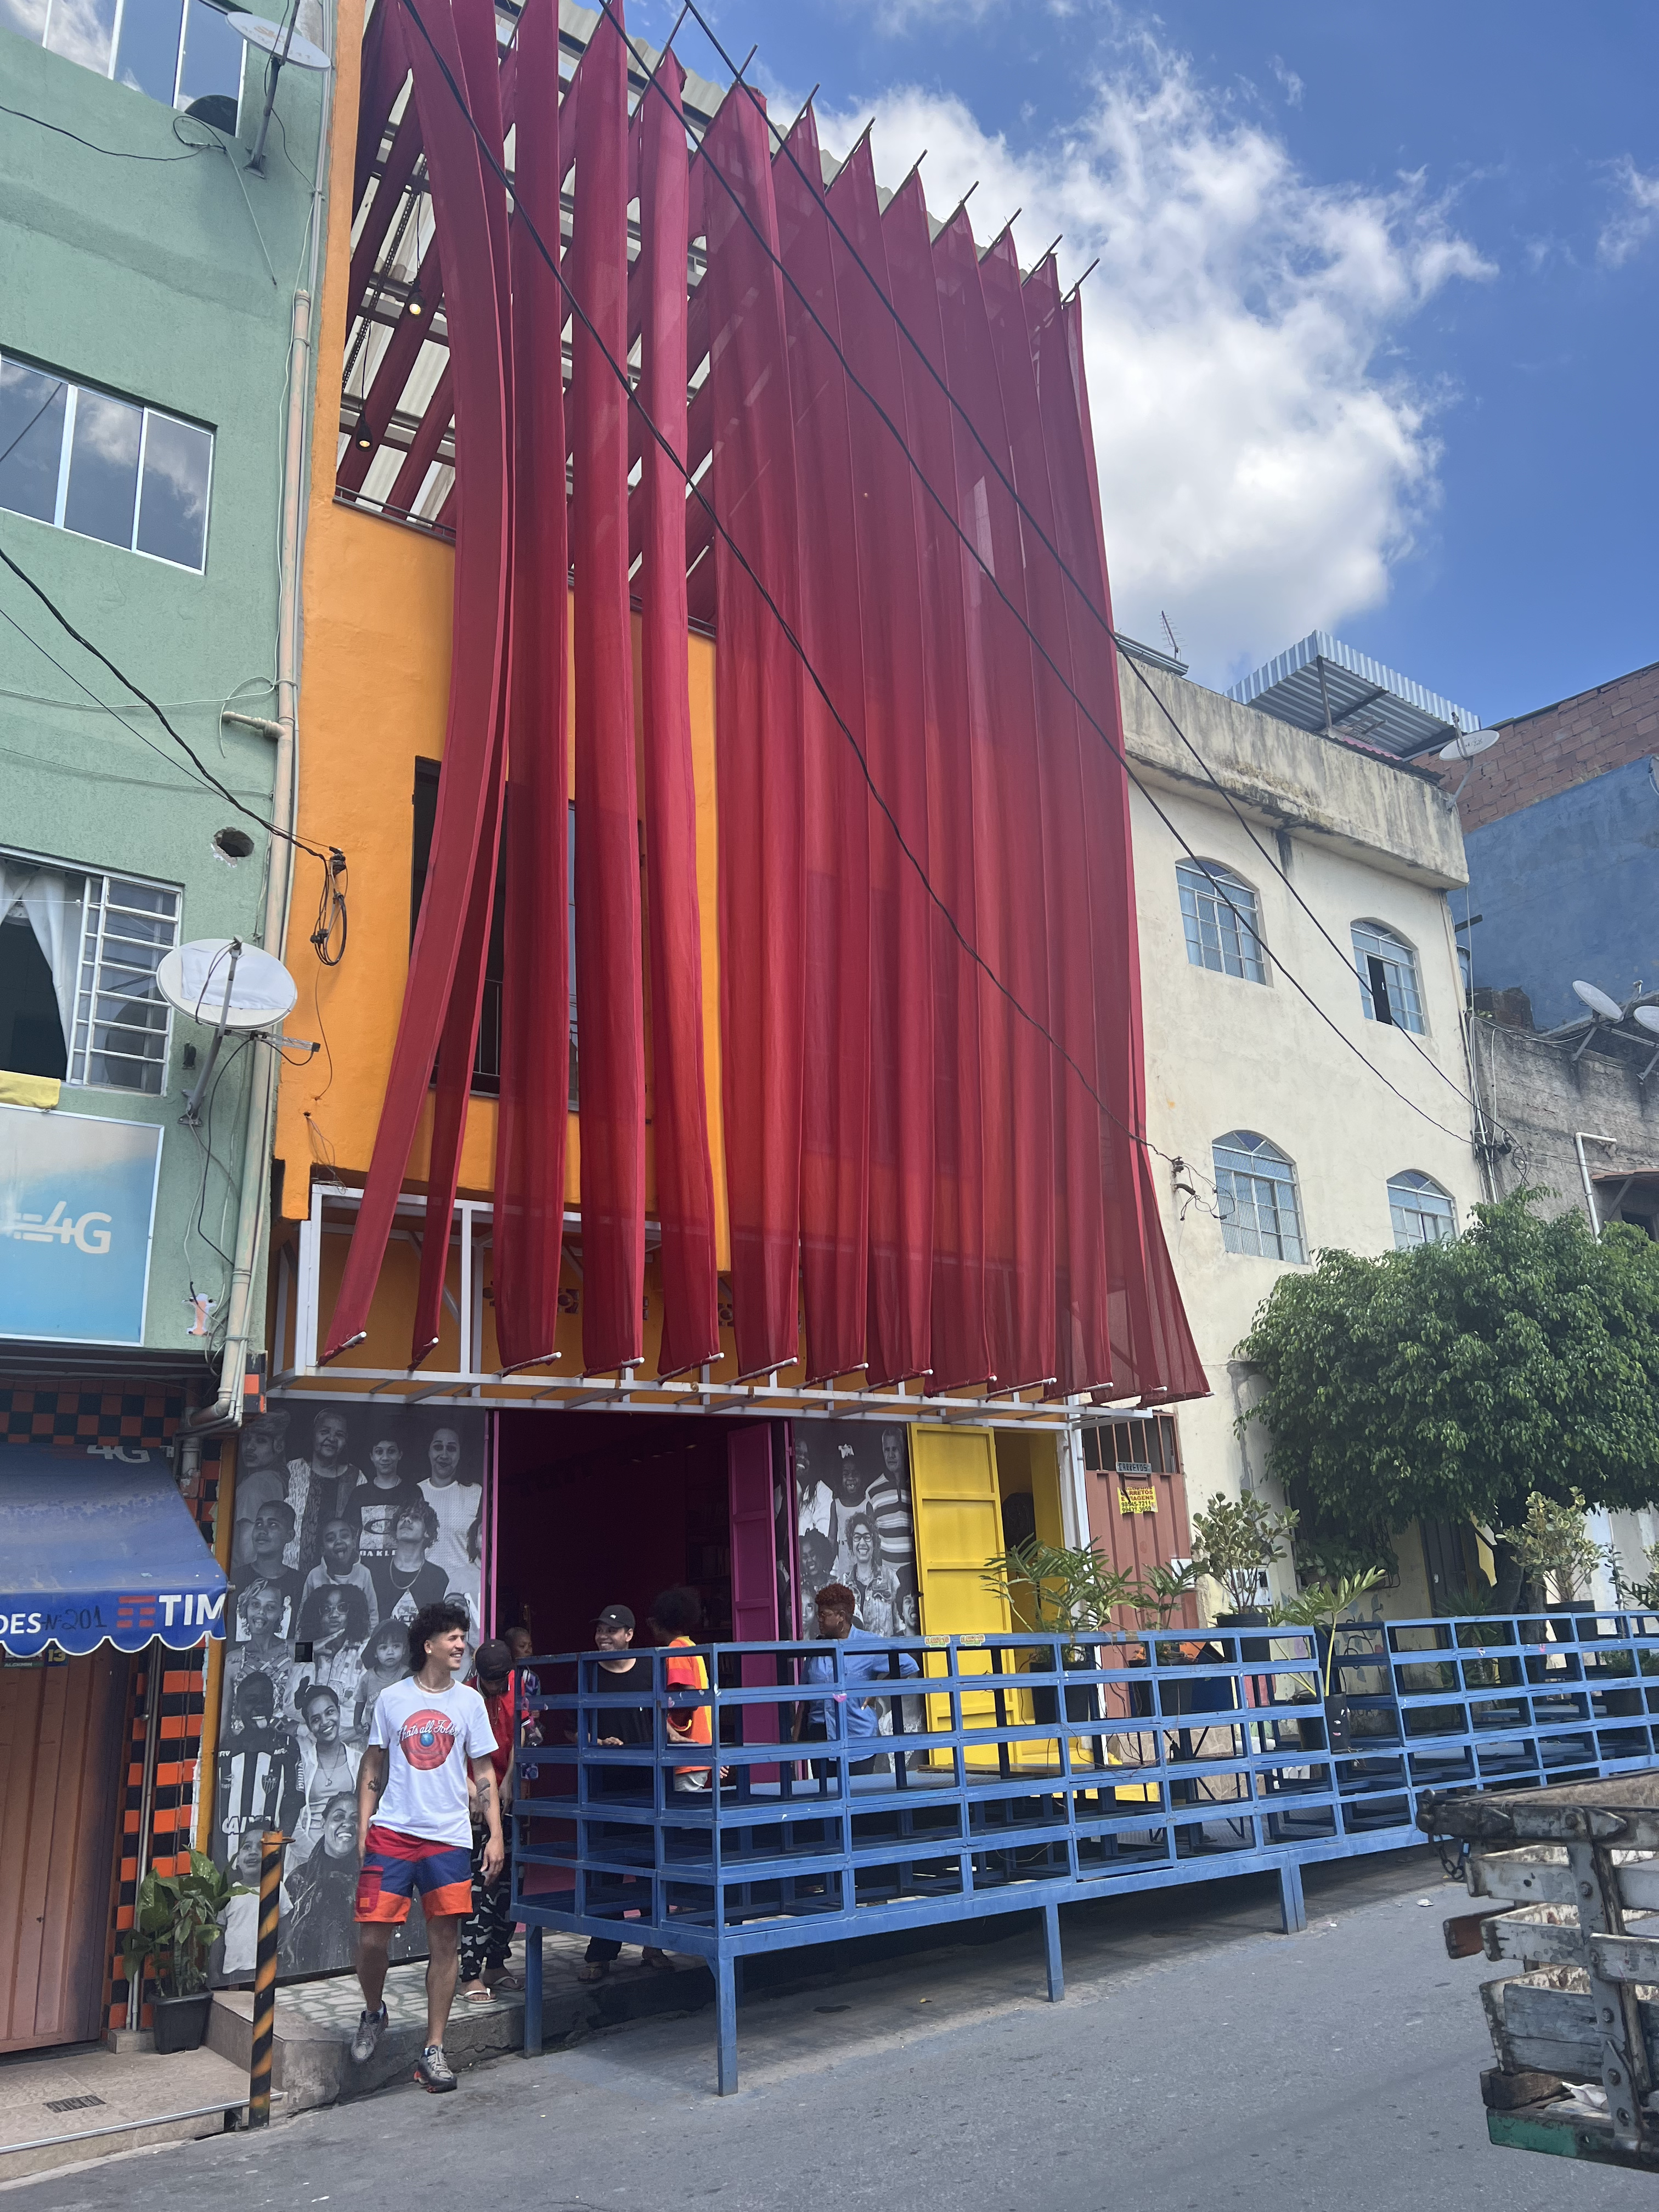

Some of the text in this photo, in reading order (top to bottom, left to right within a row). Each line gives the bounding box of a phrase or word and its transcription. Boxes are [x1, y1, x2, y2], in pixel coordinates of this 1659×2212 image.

[40, 1200, 112, 1254] 4G
[1118, 1463, 1148, 1471] CARRETOS
[61, 1605, 108, 1630] 201
[159, 1593, 226, 1626] TIM
[48, 1649, 66, 1662] 13
[419, 1719, 435, 1734] all
